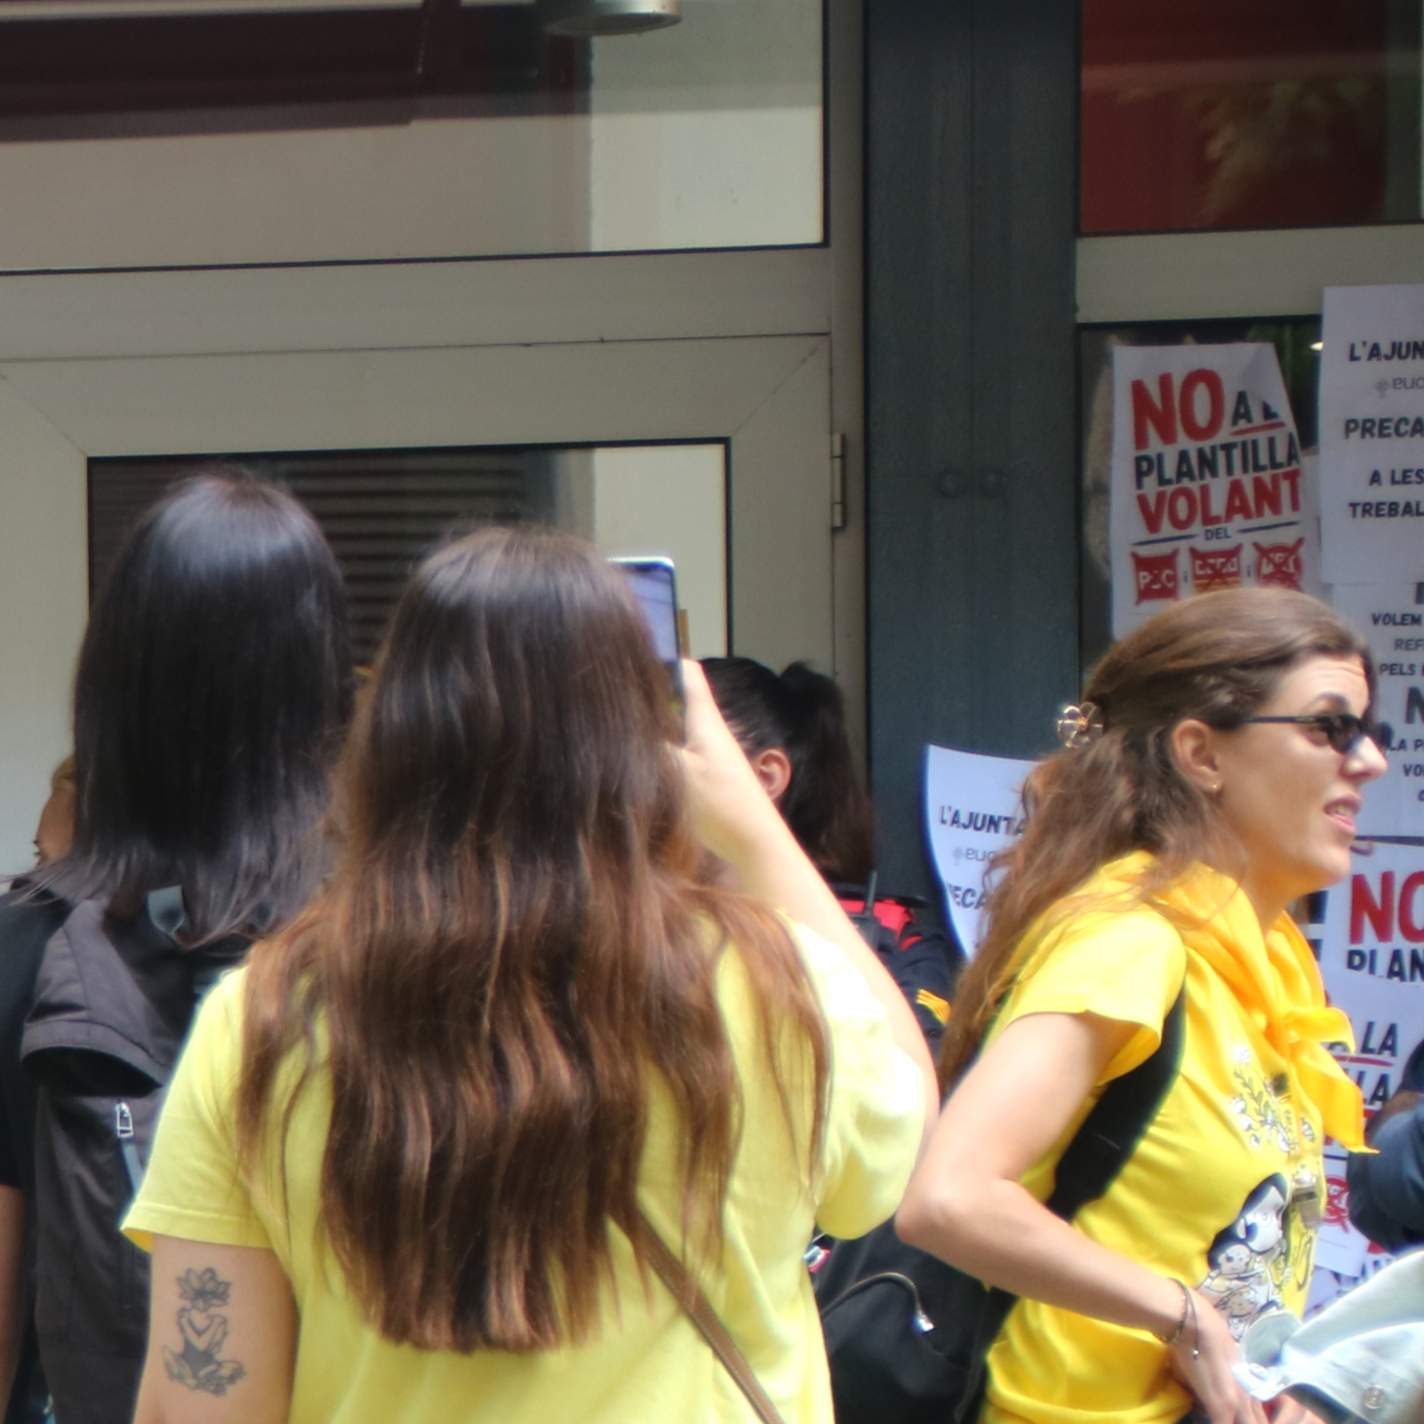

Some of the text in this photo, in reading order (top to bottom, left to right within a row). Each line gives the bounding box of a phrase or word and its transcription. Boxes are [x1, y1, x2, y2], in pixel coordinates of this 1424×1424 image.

[1131, 367, 1226, 451] NO
[1231, 389, 1253, 427] A
[1134, 432, 1301, 490] PLANTILLA
[1369, 469, 1382, 486] A
[1136, 468, 1301, 535] VOLANT
[1204, 528, 1232, 541] DEL
[1371, 612, 1422, 627] VOLEM
[1380, 663, 1416, 677] PELS
